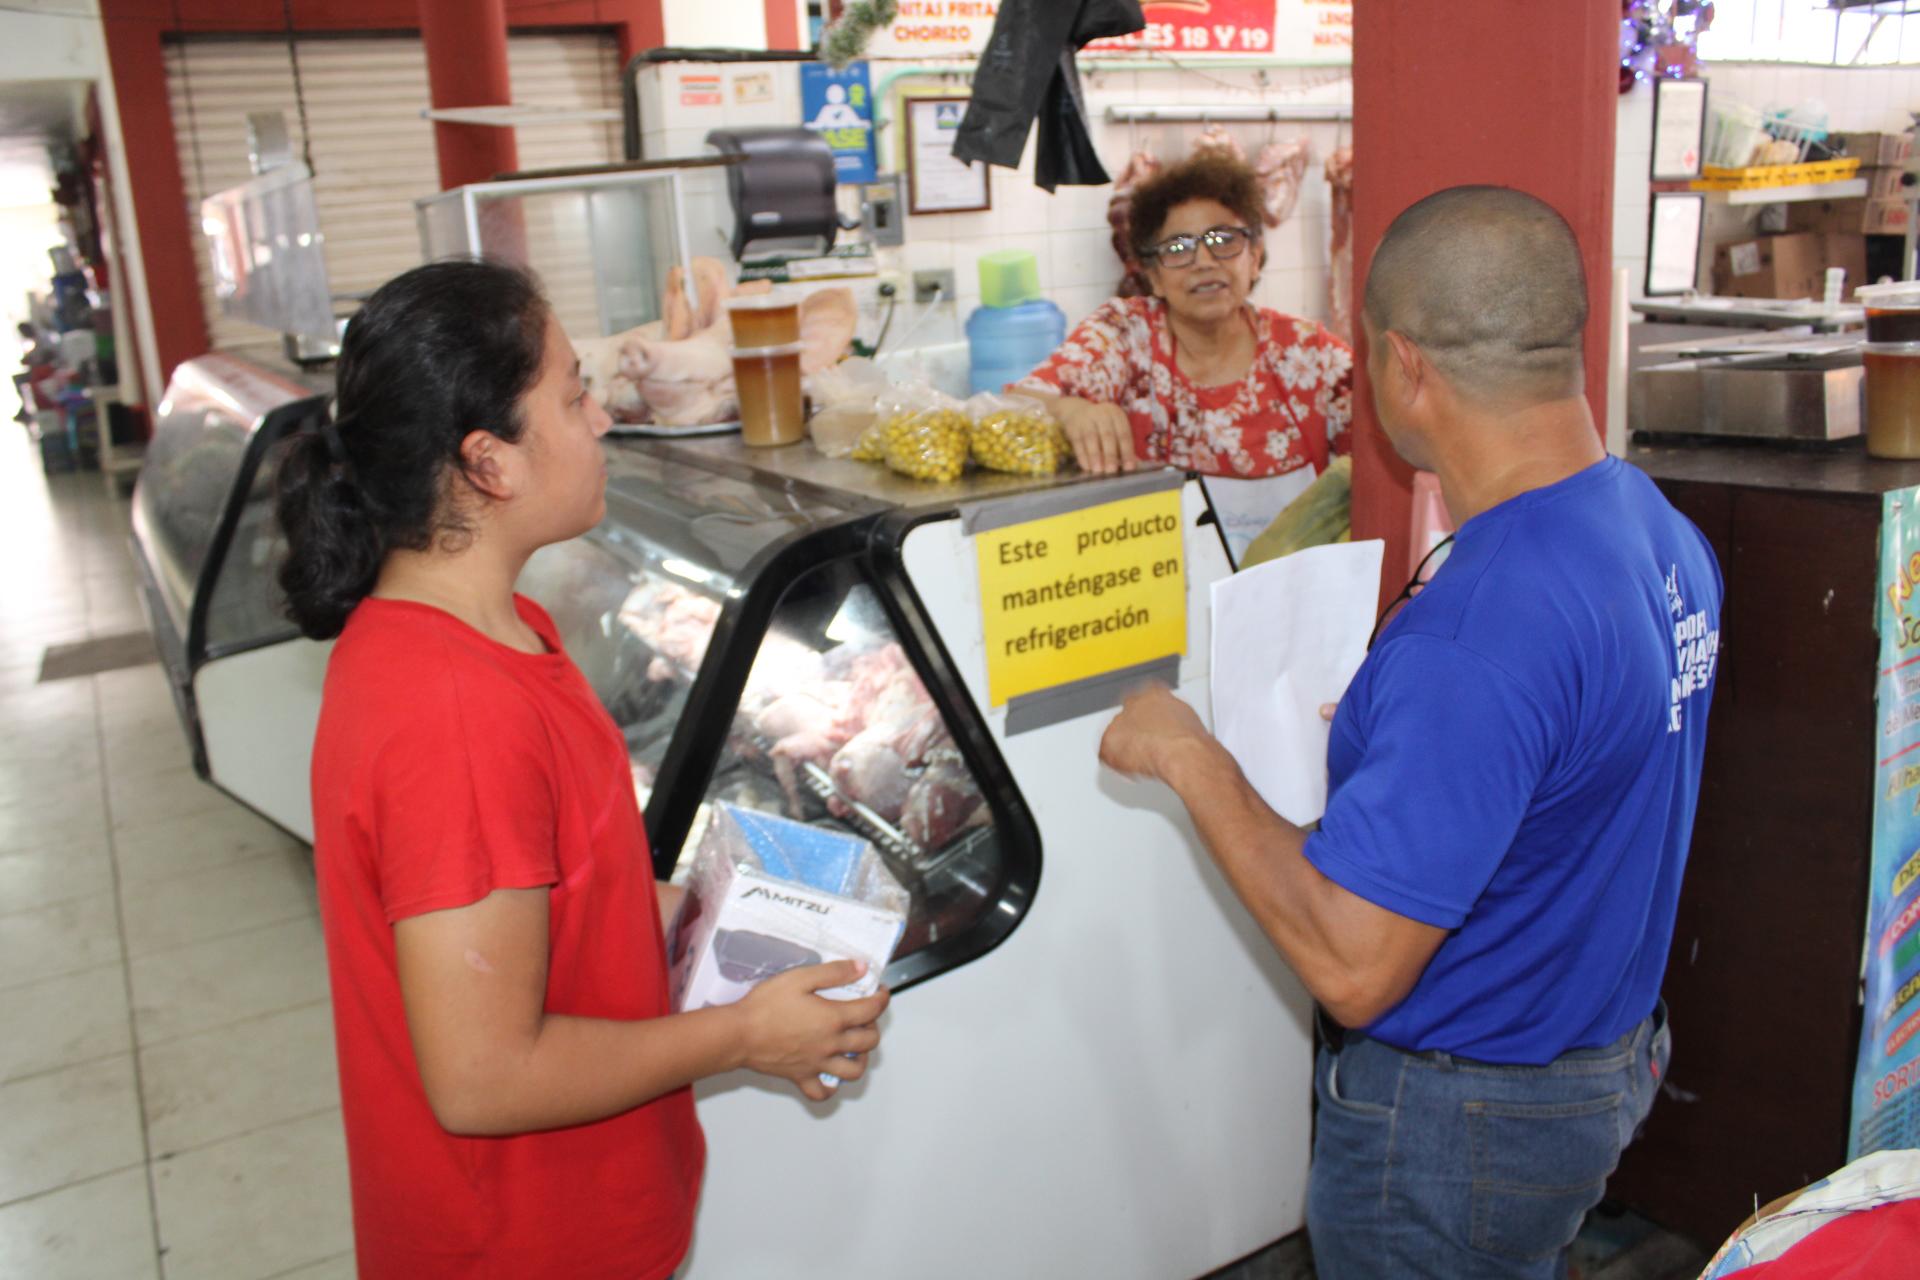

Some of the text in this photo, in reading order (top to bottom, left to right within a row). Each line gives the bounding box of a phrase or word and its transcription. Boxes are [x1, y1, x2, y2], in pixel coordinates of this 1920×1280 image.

[894, 25, 971, 42] CHORIZO
[1180, 26, 1209, 48] 18
[1213, 25, 1236, 49] Y
[1240, 27, 1269, 49] 19
[998, 513, 1177, 565] Este producto
[1002, 557, 1179, 611] manténgase en
[1005, 604, 1150, 657] refrigeración
